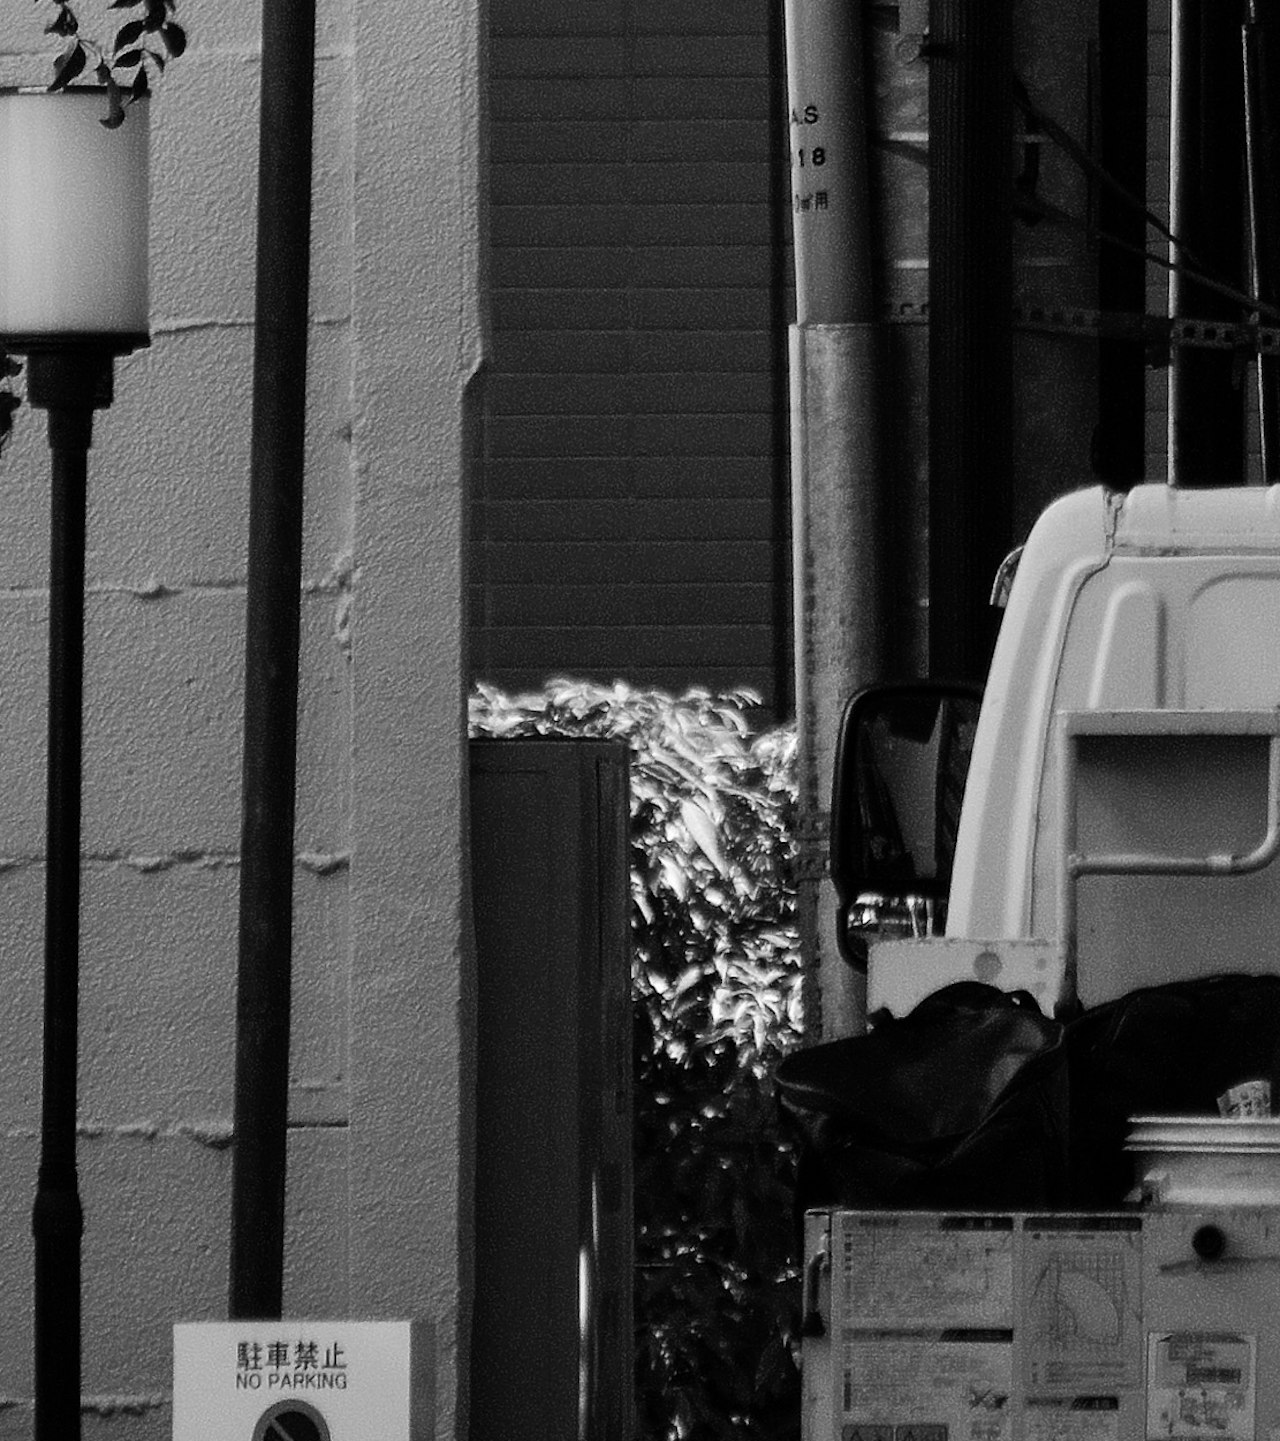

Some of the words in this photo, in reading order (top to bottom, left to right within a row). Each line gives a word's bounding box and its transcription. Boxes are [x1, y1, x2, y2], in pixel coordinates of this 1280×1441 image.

[236, 1342, 347, 1371] 駐車禁止
[236, 1374, 262, 1389] NO
[268, 1374, 347, 1390] PARKING
